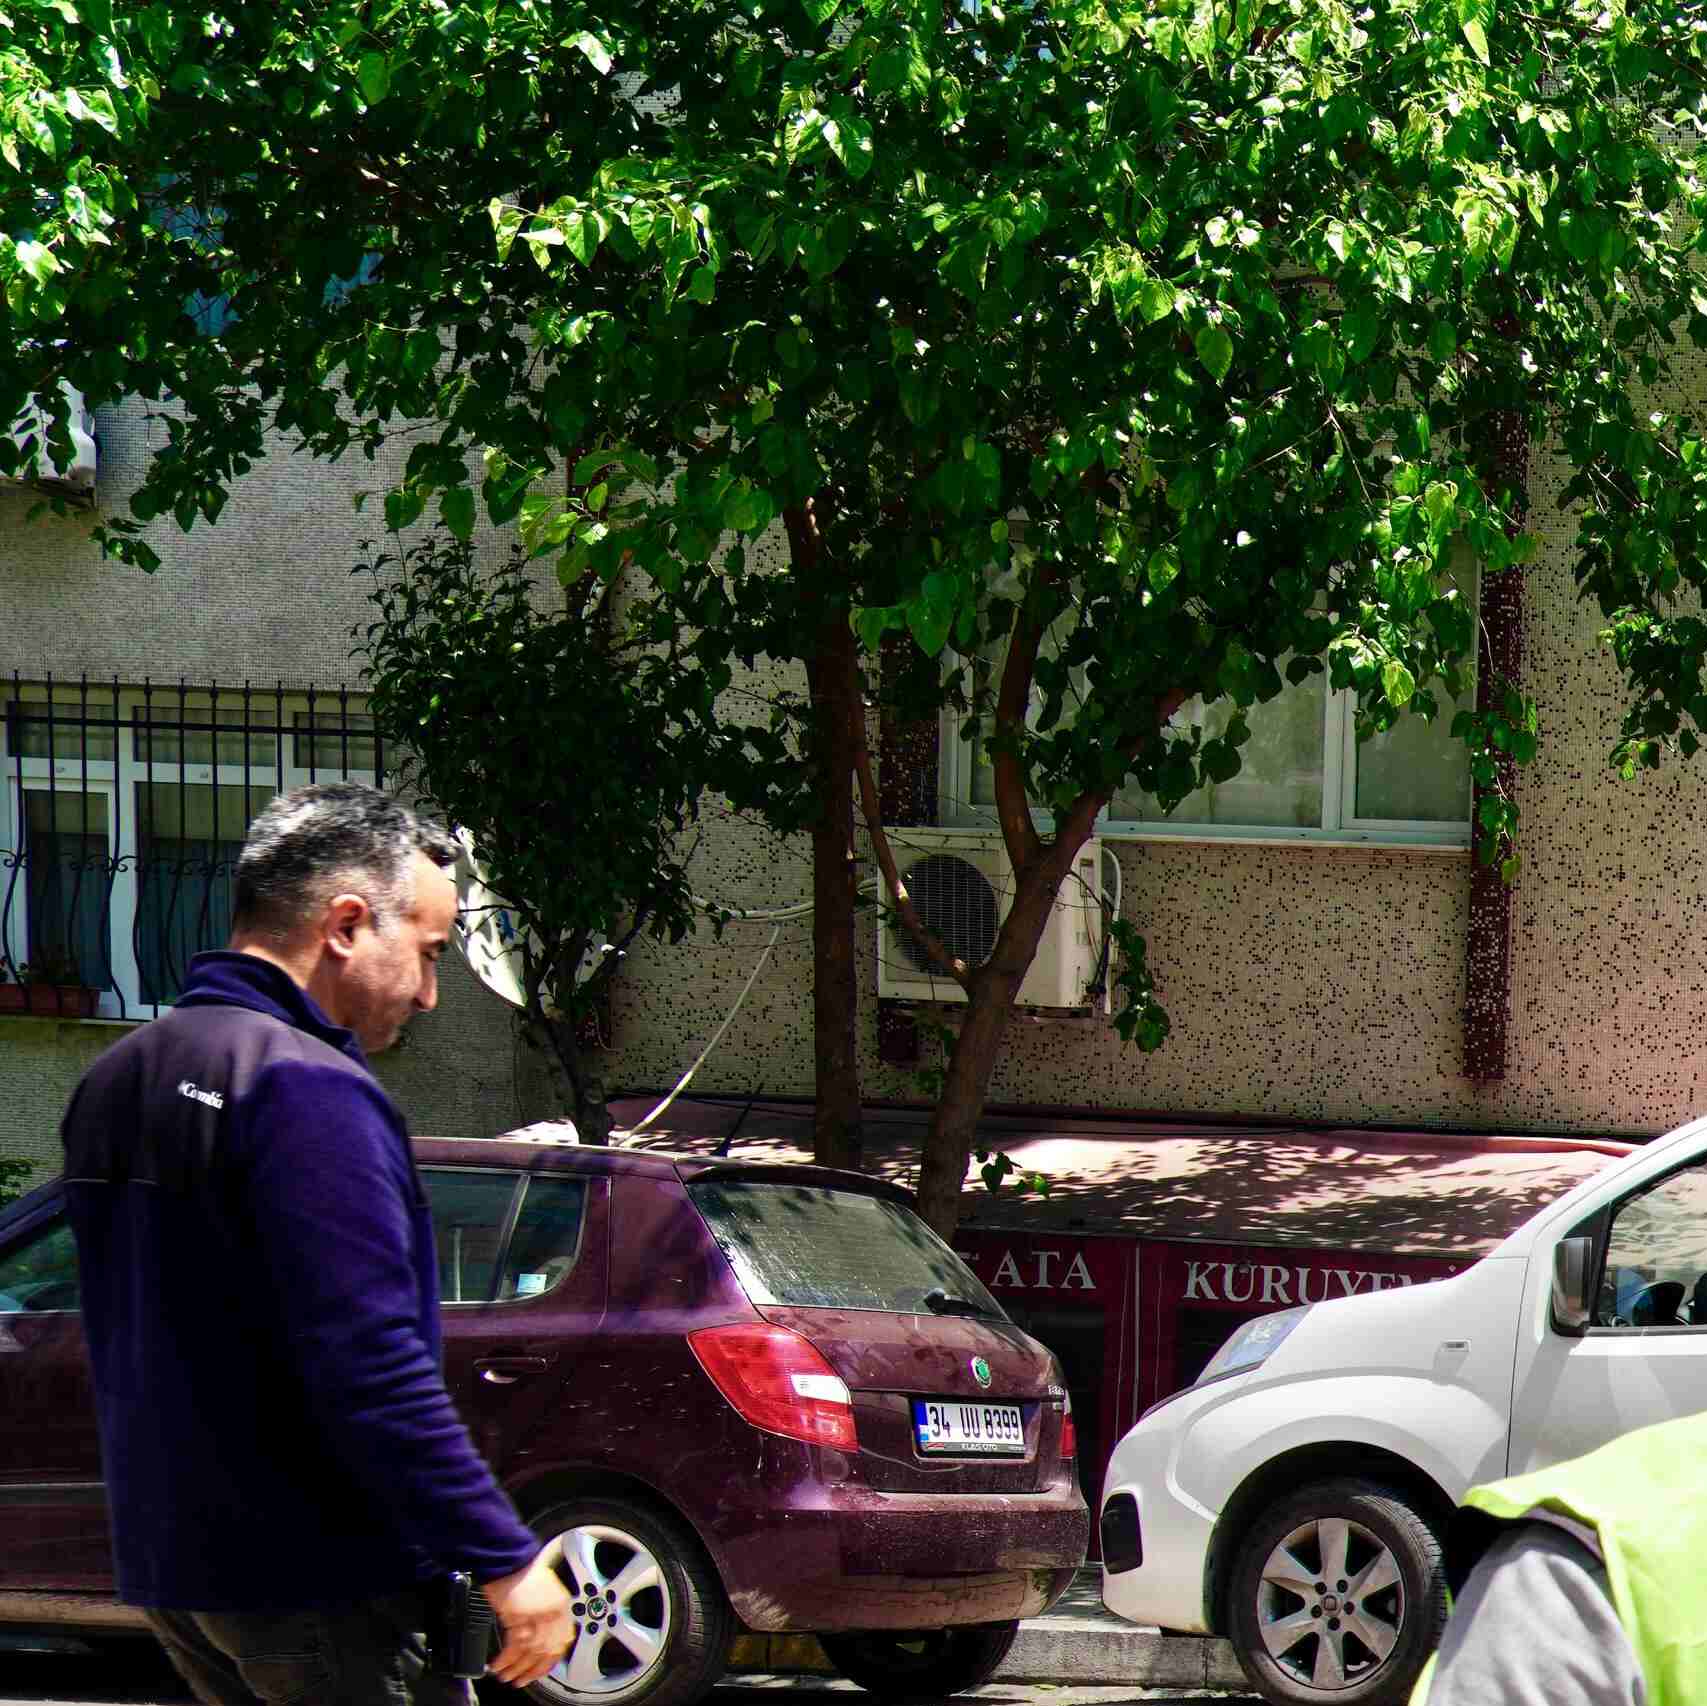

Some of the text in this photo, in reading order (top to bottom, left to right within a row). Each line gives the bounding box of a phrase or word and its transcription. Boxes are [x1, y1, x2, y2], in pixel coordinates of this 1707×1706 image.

[990, 1249, 1456, 1305] ATA KURUYE
[929, 1406, 1020, 1441] 34 UU 8399
